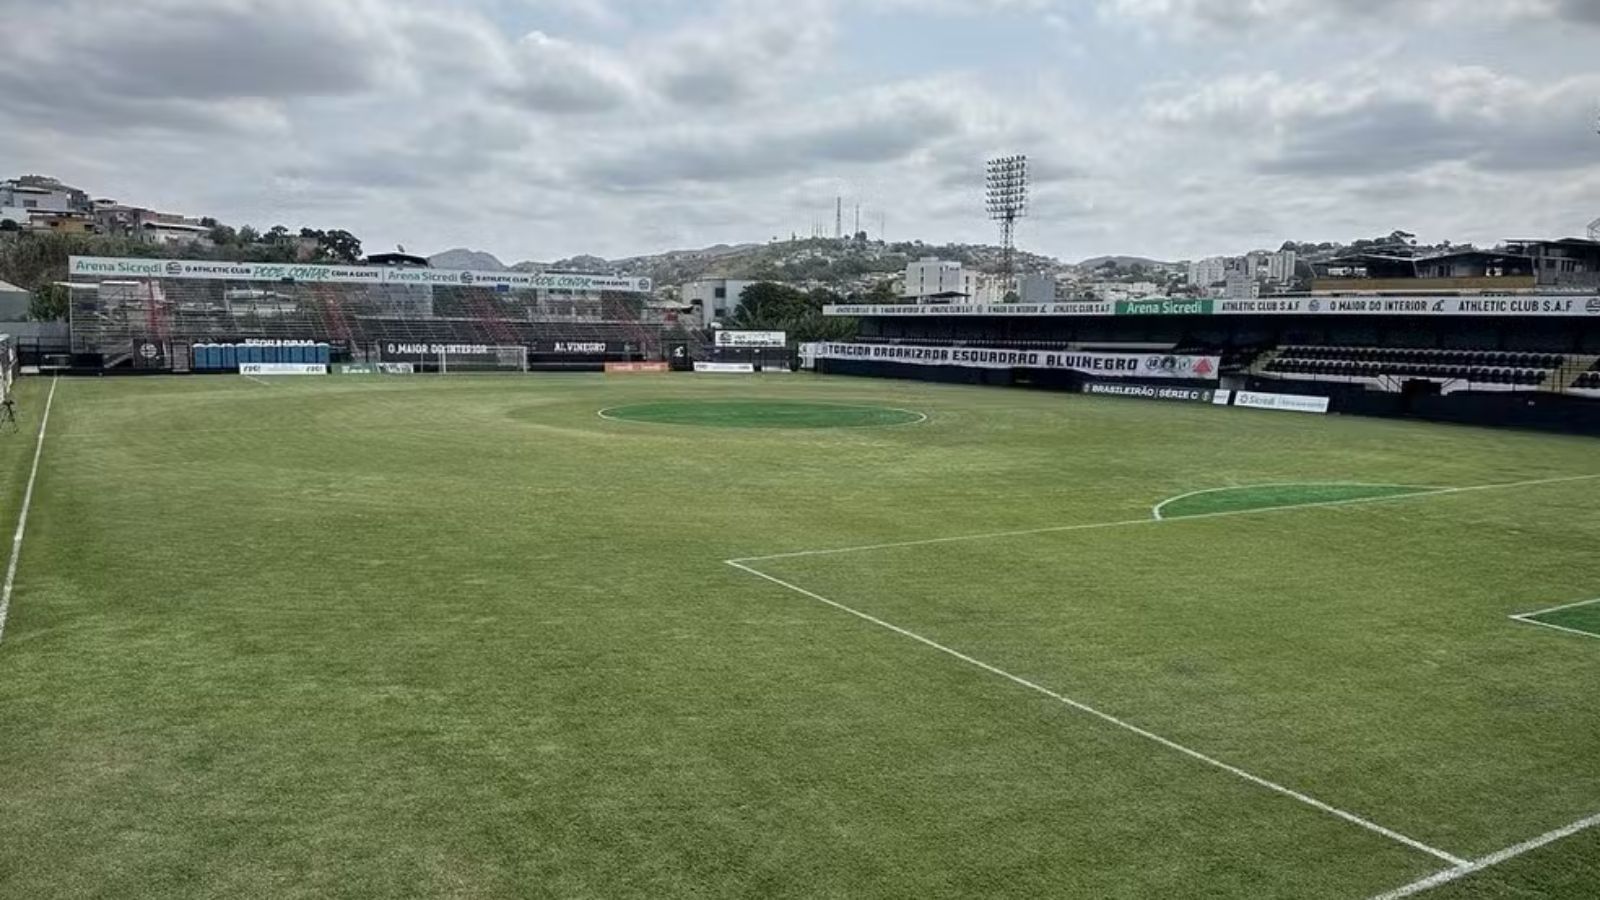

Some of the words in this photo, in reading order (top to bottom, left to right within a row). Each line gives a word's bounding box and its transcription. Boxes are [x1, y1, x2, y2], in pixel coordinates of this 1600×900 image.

[76, 260, 115, 272] Arena
[118, 261, 162, 273] Sicredi
[193, 266, 229, 274] ATHLETIC
[231, 267, 250, 275] CLUB
[388, 271, 420, 281] Arena
[422, 270, 458, 282] Sicredi
[1126, 301, 1159, 314] Arena
[1163, 300, 1202, 314] Sicredi
[1222, 301, 1255, 311] ATHLETIC
[1257, 301, 1277, 311] CLUB
[1329, 301, 1336, 311] O
[1339, 301, 1366, 311] MAIOR
[1369, 301, 1381, 311] DO
[1384, 301, 1427, 312] INTERIOR
[1458, 300, 1507, 312] ATHLETIC
[1510, 300, 1539, 312] CLUB
[388, 343, 396, 354] O
[396, 343, 428, 354] MAIOR
[446, 344, 488, 354] INTERIOR
[554, 342, 606, 352] ALVINEGRO
[828, 344, 871, 356] TORCIDA
[873, 347, 948, 360] ORGANIZADA
[1046, 353, 1139, 371] ALVINEGRO
[1092, 384, 1154, 397] BRASILEIRÃO
[1159, 387, 1189, 399] SÉRIE
[1190, 390, 1199, 400] C
